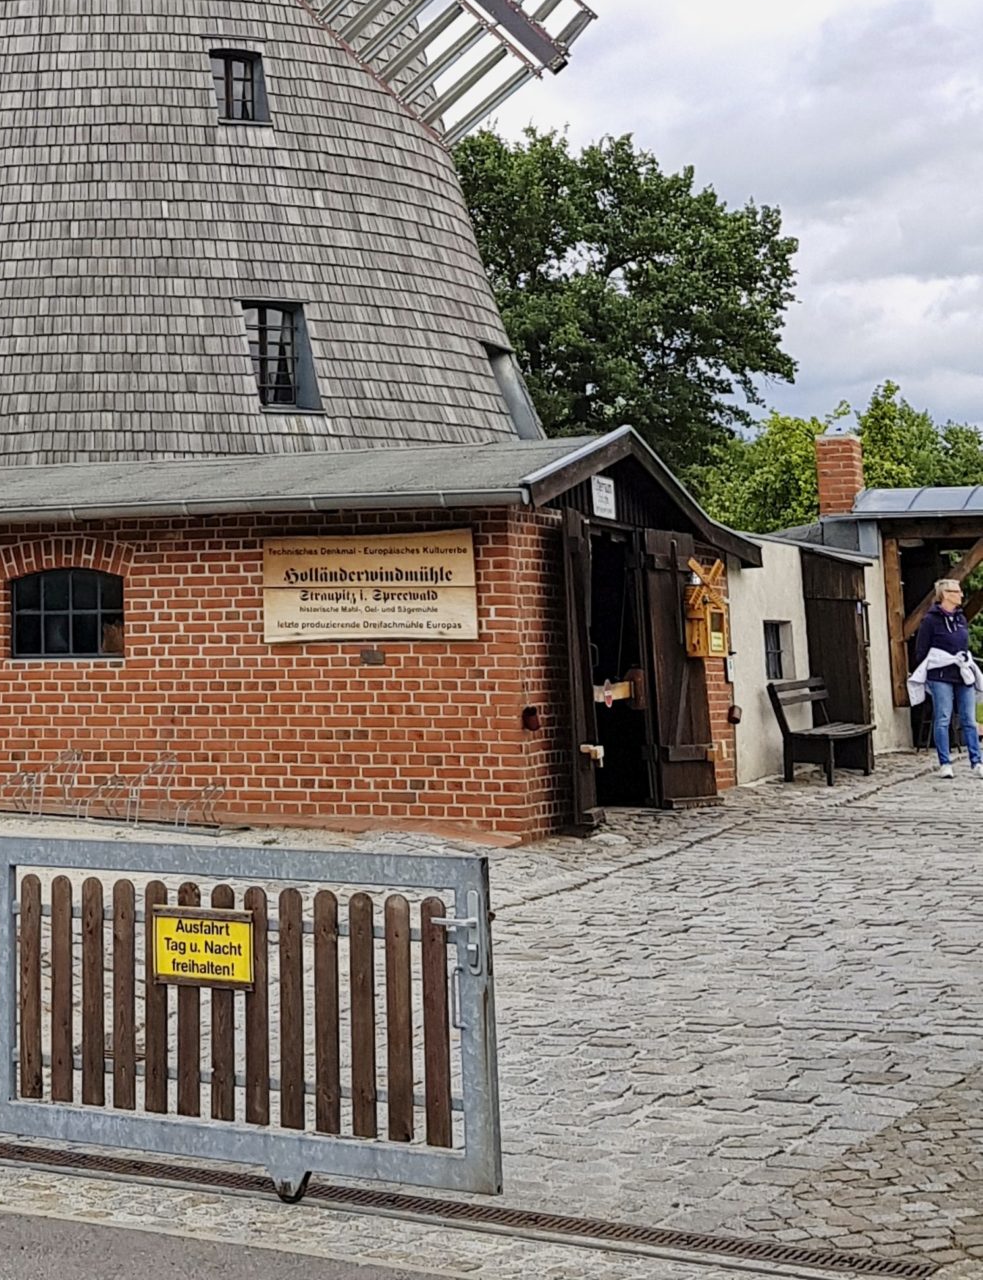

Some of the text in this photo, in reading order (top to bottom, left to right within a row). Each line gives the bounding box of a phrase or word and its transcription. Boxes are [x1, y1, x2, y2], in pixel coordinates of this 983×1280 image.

[268, 548, 317, 556] Technisches
[320, 547, 356, 555] Denkmal
[363, 547, 420, 555] Europäisches
[284, 566, 452, 584] Holländerwindmühle
[300, 589, 438, 604] Straupitz i. Spreewald
[397, 606, 438, 614] Sägemühle
[277, 620, 462, 630] letzte produzierende Dreifachmühle Europas
[175, 919, 230, 936] Ausfahrt
[164, 937, 242, 956] Tag u. Nacht
[172, 958, 235, 976] freihalten!
